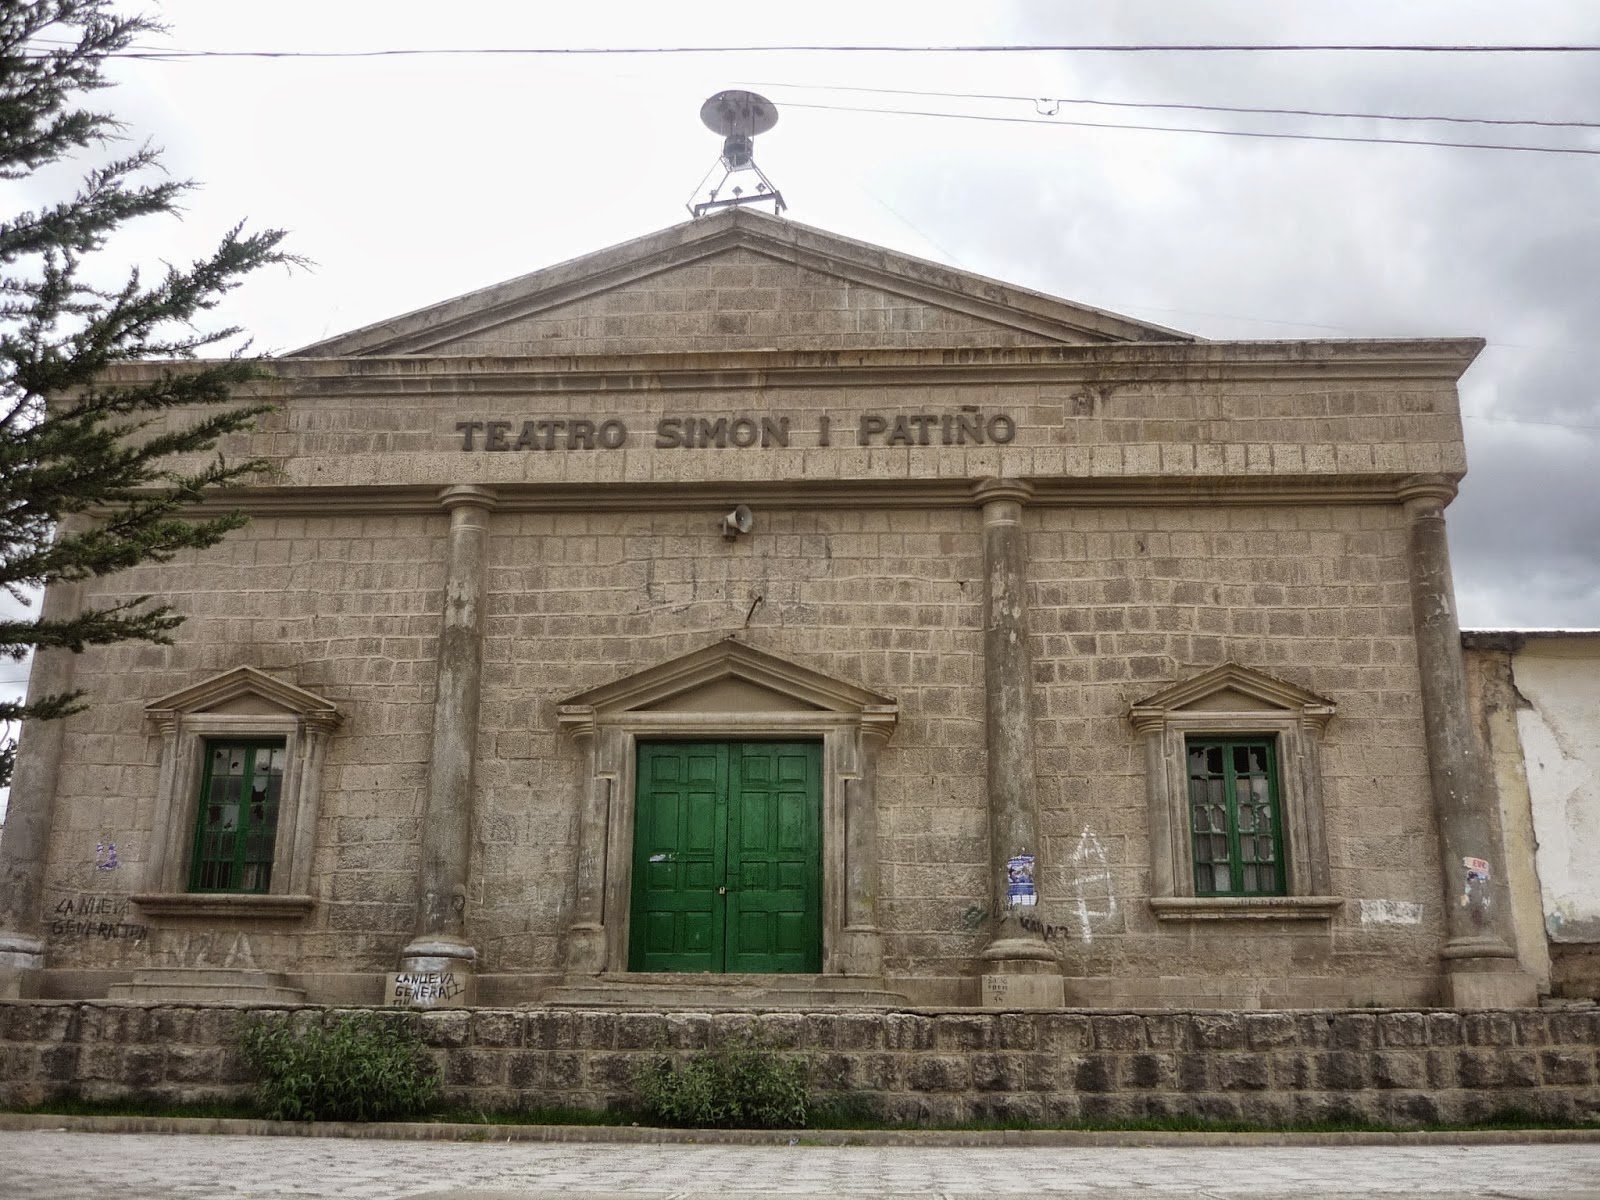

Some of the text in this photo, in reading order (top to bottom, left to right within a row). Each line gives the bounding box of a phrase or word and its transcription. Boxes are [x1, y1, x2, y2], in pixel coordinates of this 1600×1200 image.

[456, 418, 627, 452] TEATRO
[655, 416, 789, 450] SIMON
[819, 416, 831, 447] I
